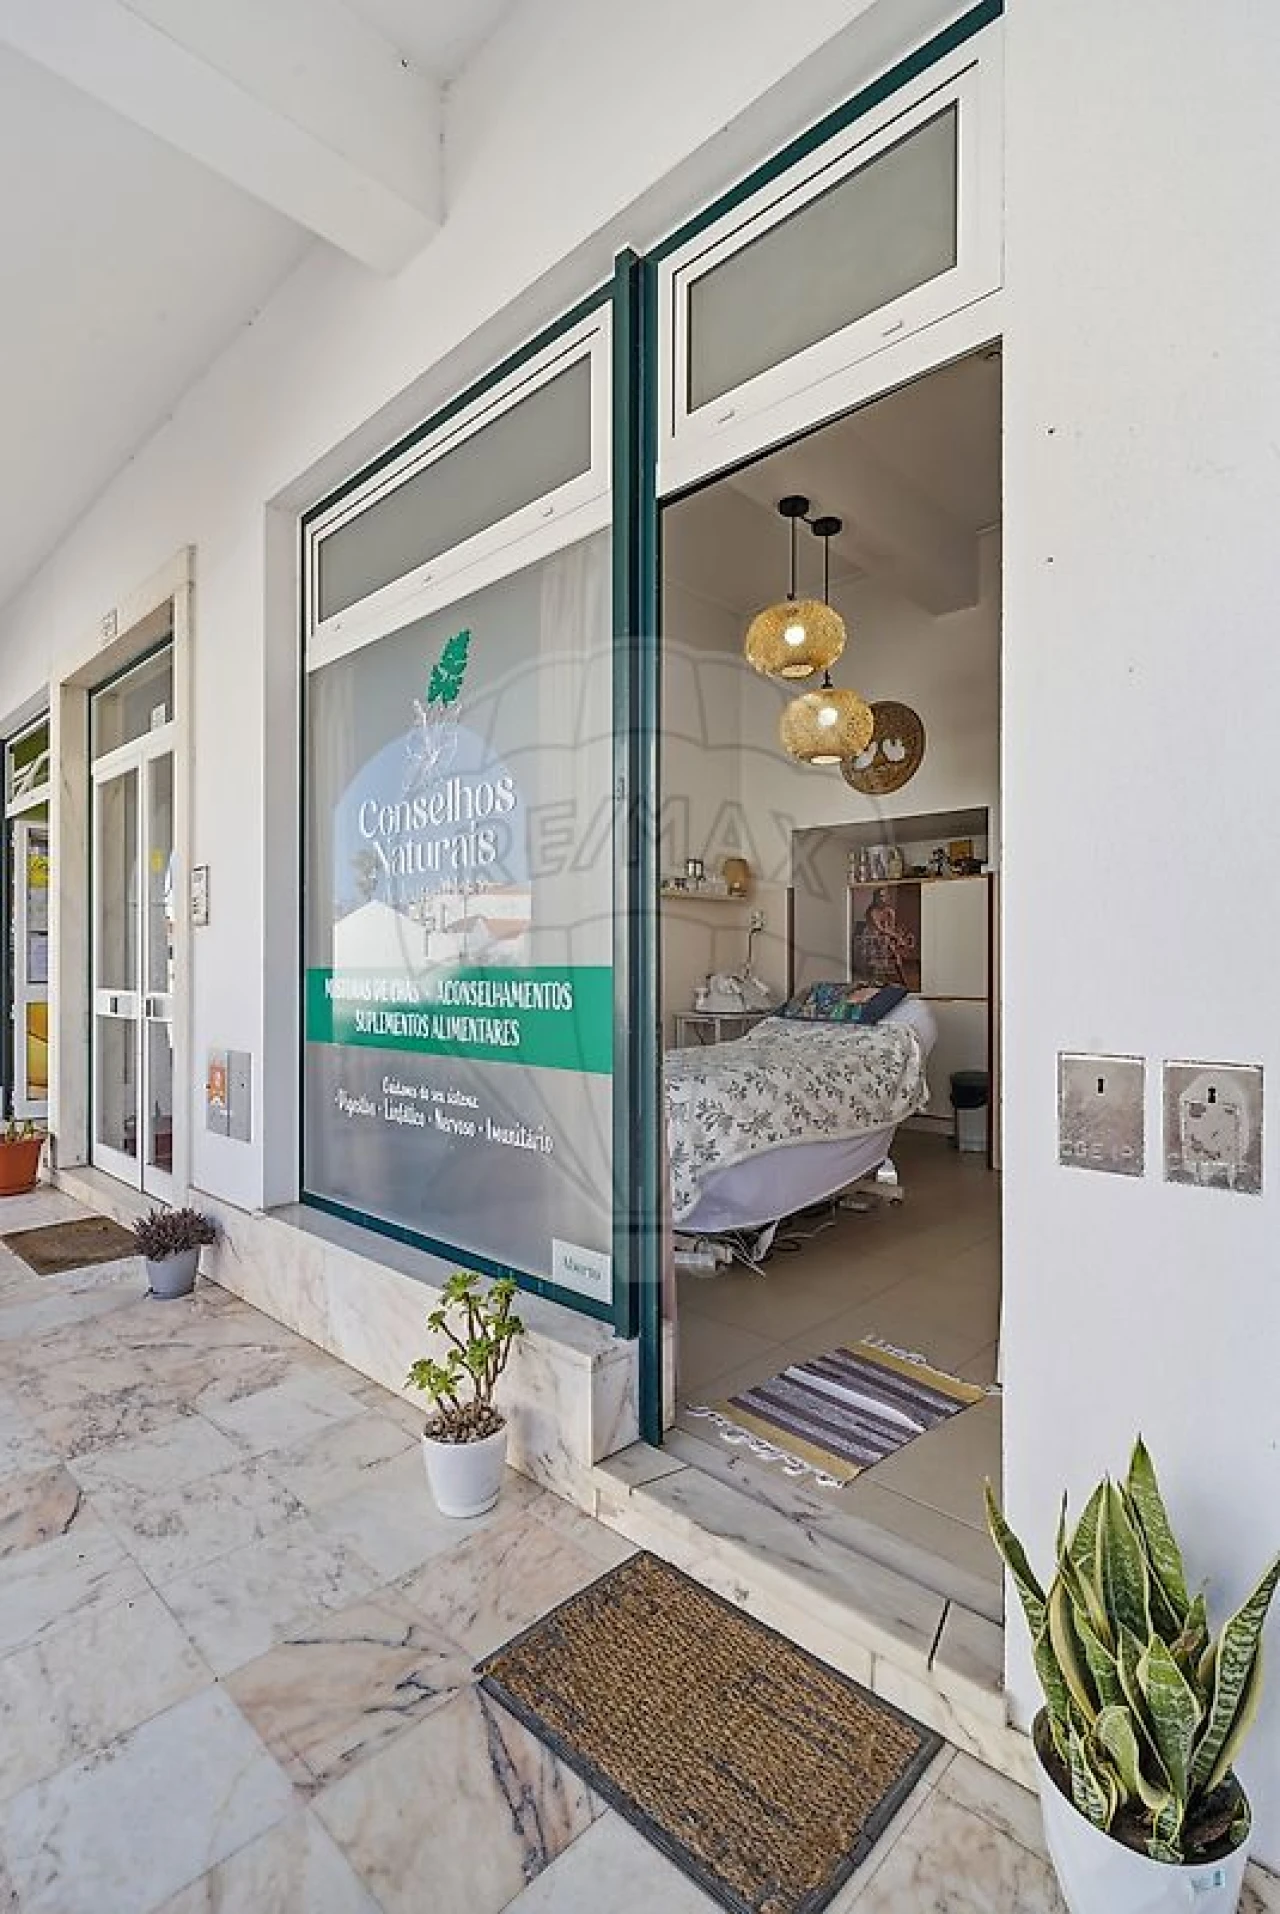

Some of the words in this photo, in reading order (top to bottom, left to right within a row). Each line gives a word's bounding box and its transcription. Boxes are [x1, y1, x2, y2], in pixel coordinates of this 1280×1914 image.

[358, 776, 516, 838] Conselhos
[373, 820, 496, 876] Naturais
[437, 980, 573, 1011] ACONSELHAMENTOS
[355, 1009, 429, 1038] SUPLEMENTOS
[430, 1014, 520, 1046] ALIMENTARES
